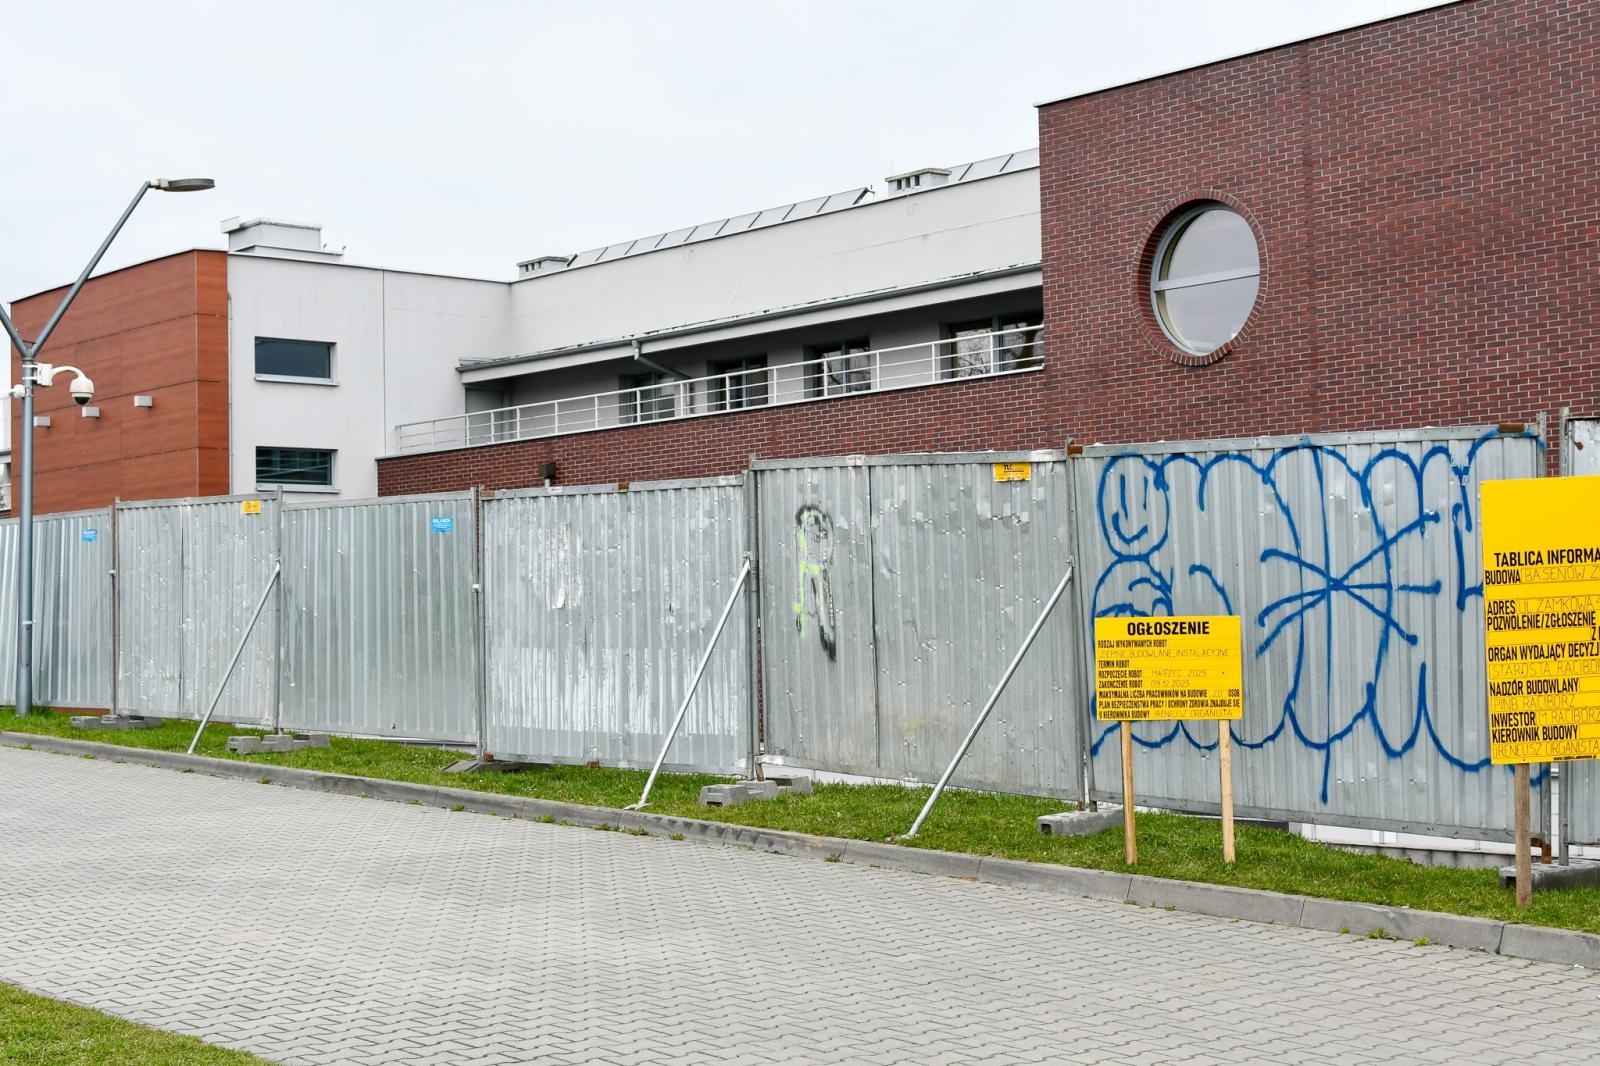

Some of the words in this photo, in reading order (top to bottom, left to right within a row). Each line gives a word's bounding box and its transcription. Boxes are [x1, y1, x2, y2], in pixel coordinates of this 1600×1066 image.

[1494, 550, 1544, 567] TABLICA
[1485, 569, 1521, 585] BUDOWA
[1487, 600, 1516, 616] ADRES
[1536, 595, 1595, 613] ZAMKOWA
[1127, 621, 1210, 636] OGŁOSZENIE
[1487, 611, 1596, 631] POZWOLENIE/ZGŁOSZENIE
[1098, 639, 1115, 648] RODZAJ
[1116, 639, 1152, 648] WYKONYWANYCH
[1176, 648, 1229, 657] INSTALACYJNE
[1488, 646, 1518, 662] ORGAN
[1520, 643, 1566, 661] WYDAJĄCY
[1098, 660, 1115, 669] TERMIN
[1492, 662, 1552, 677] STAROSTA
[1187, 669, 1207, 678] 2025
[1099, 690, 1129, 699] MAKSYMALNA
[1130, 690, 1145, 699] LICZBA
[1180, 689, 1187, 698] NA
[1187, 689, 1208, 698] BUDOWIE
[1489, 679, 1524, 696] NADZÓR
[1526, 678, 1579, 695] BUDOWLANY
[1099, 700, 1110, 709] PLAN
[1149, 699, 1164, 708] PRACY
[1167, 699, 1188, 709] OCHRONY
[1188, 699, 1209, 708] ZDROWIA
[1103, 710, 1131, 719] KIEROWNIKA
[1131, 710, 1150, 719] BUDOWY
[1491, 711, 1536, 728] INWESTOR
[1492, 727, 1540, 743] KIEROWNIK
[1542, 724, 1578, 740] BUDOWY
[1495, 742, 1542, 757] IRENEUSZ
[1545, 739, 1600, 754] ORGANISTA
